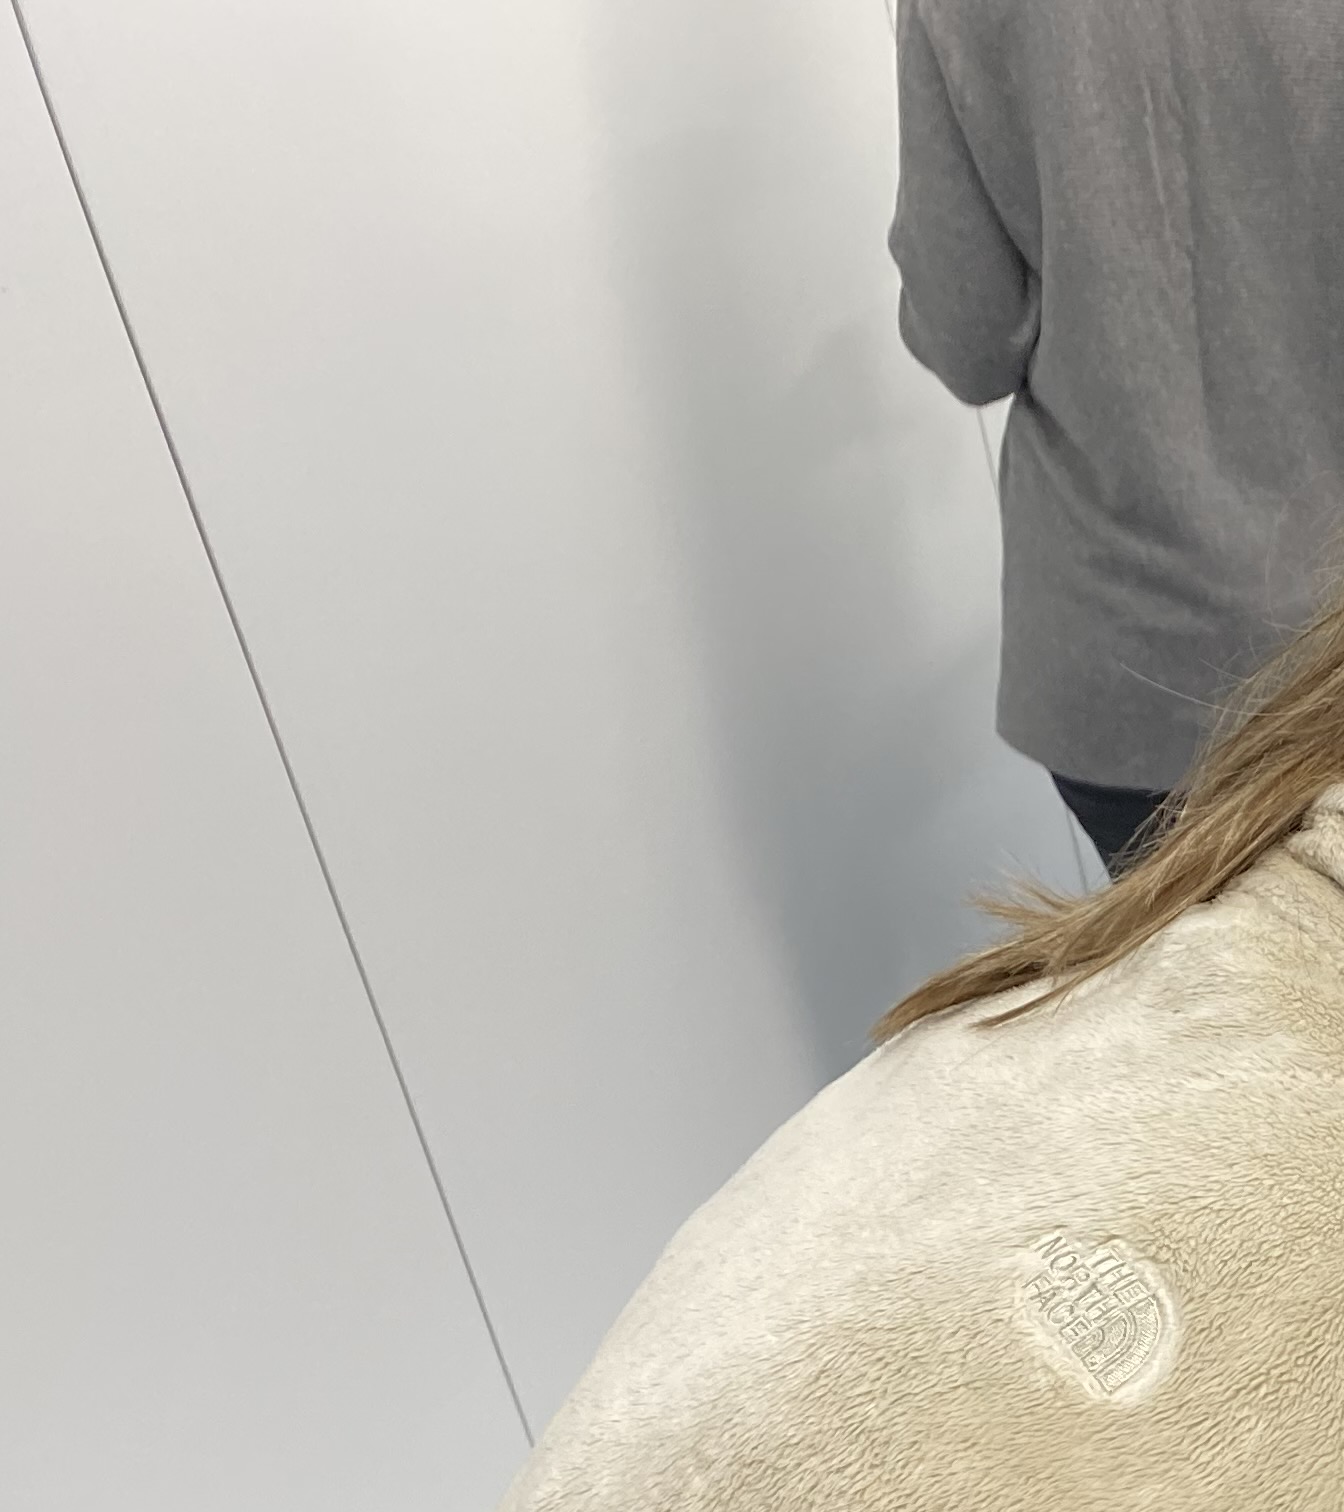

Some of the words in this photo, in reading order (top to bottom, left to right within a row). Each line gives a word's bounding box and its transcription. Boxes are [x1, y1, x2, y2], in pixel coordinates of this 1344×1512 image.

[1021, 1270, 1093, 1345] FACE
[1034, 1235, 1118, 1325] NORTH
[1089, 1248, 1150, 1308] THE
